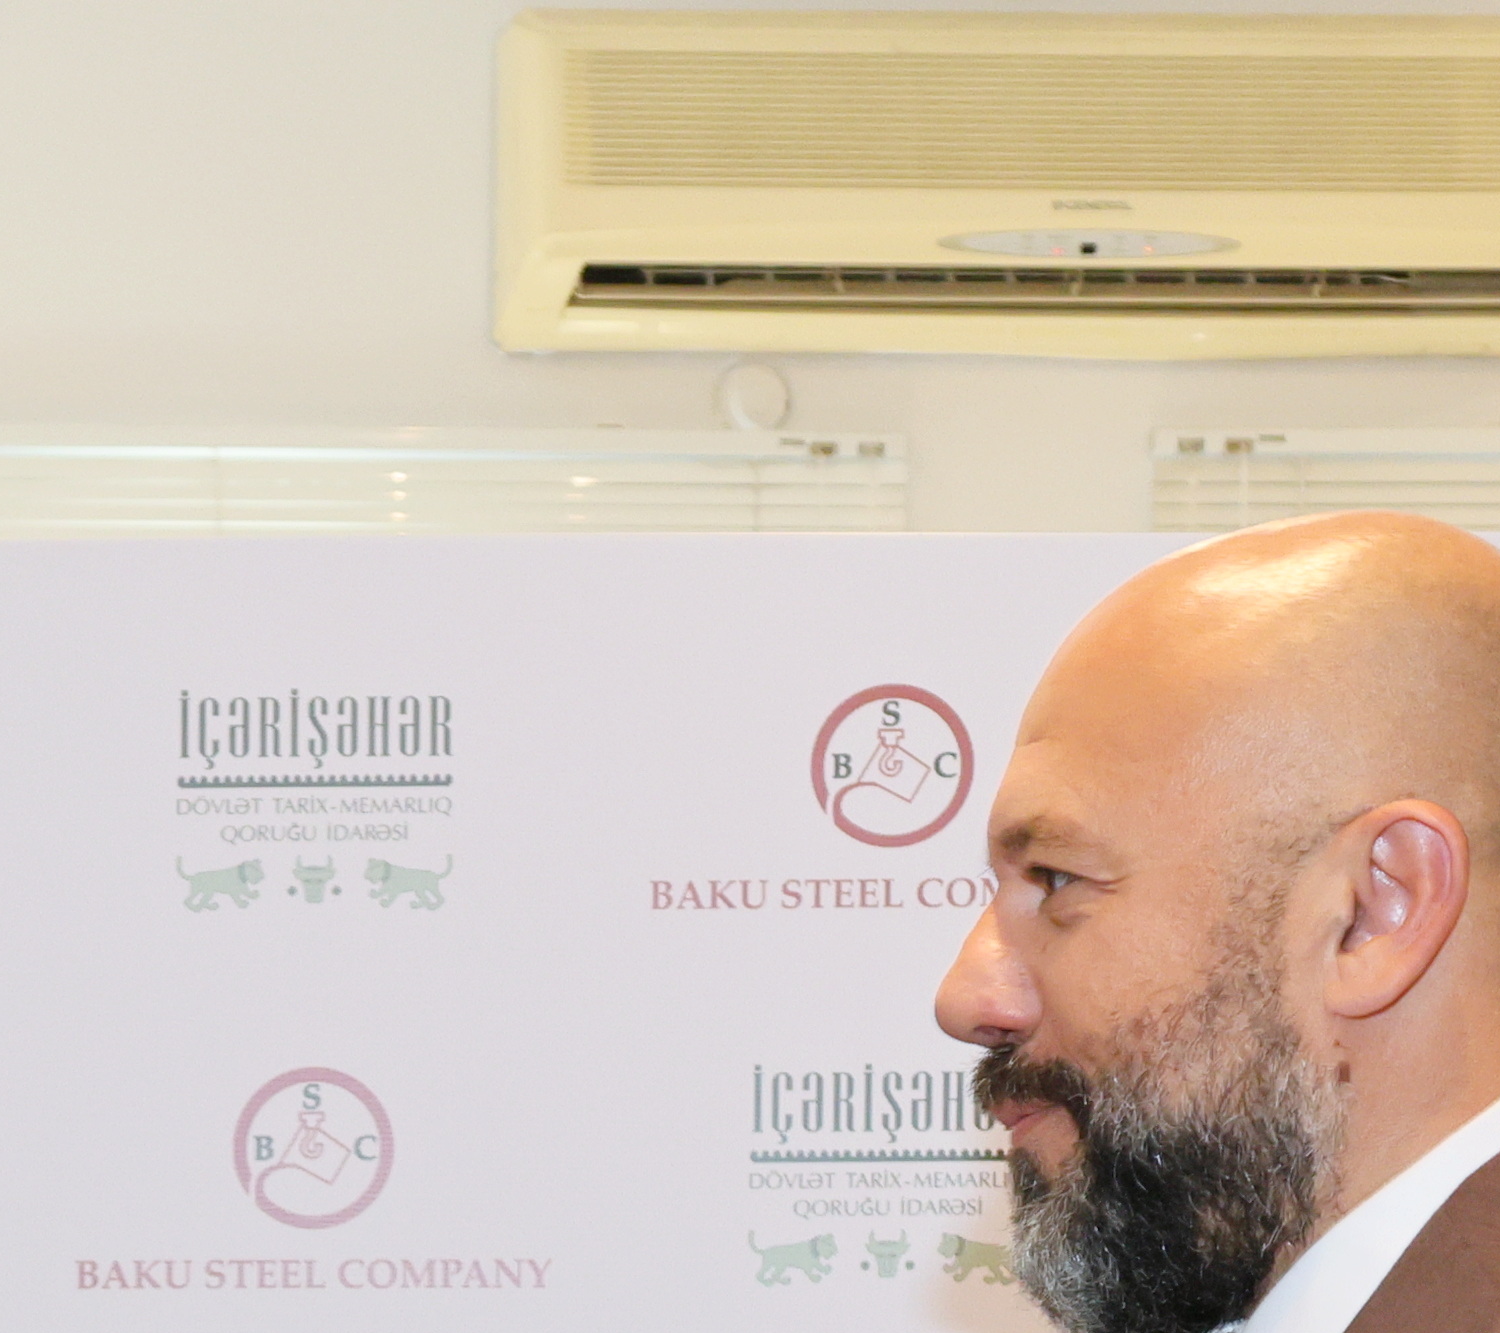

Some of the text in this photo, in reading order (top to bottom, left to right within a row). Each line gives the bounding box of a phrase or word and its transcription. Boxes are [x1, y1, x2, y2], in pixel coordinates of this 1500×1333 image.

[176, 796, 263, 815] DÖVLƏT
[220, 822, 317, 846] QORUĞU
[650, 879, 767, 910] BAKU
[780, 879, 904, 909] STEEL
[303, 1084, 321, 1110] S
[751, 1063, 998, 1143] İÇƏRİŞƏH
[254, 1135, 376, 1161] B C
[76, 1259, 550, 1289] BAKU STEEL COMPANY
